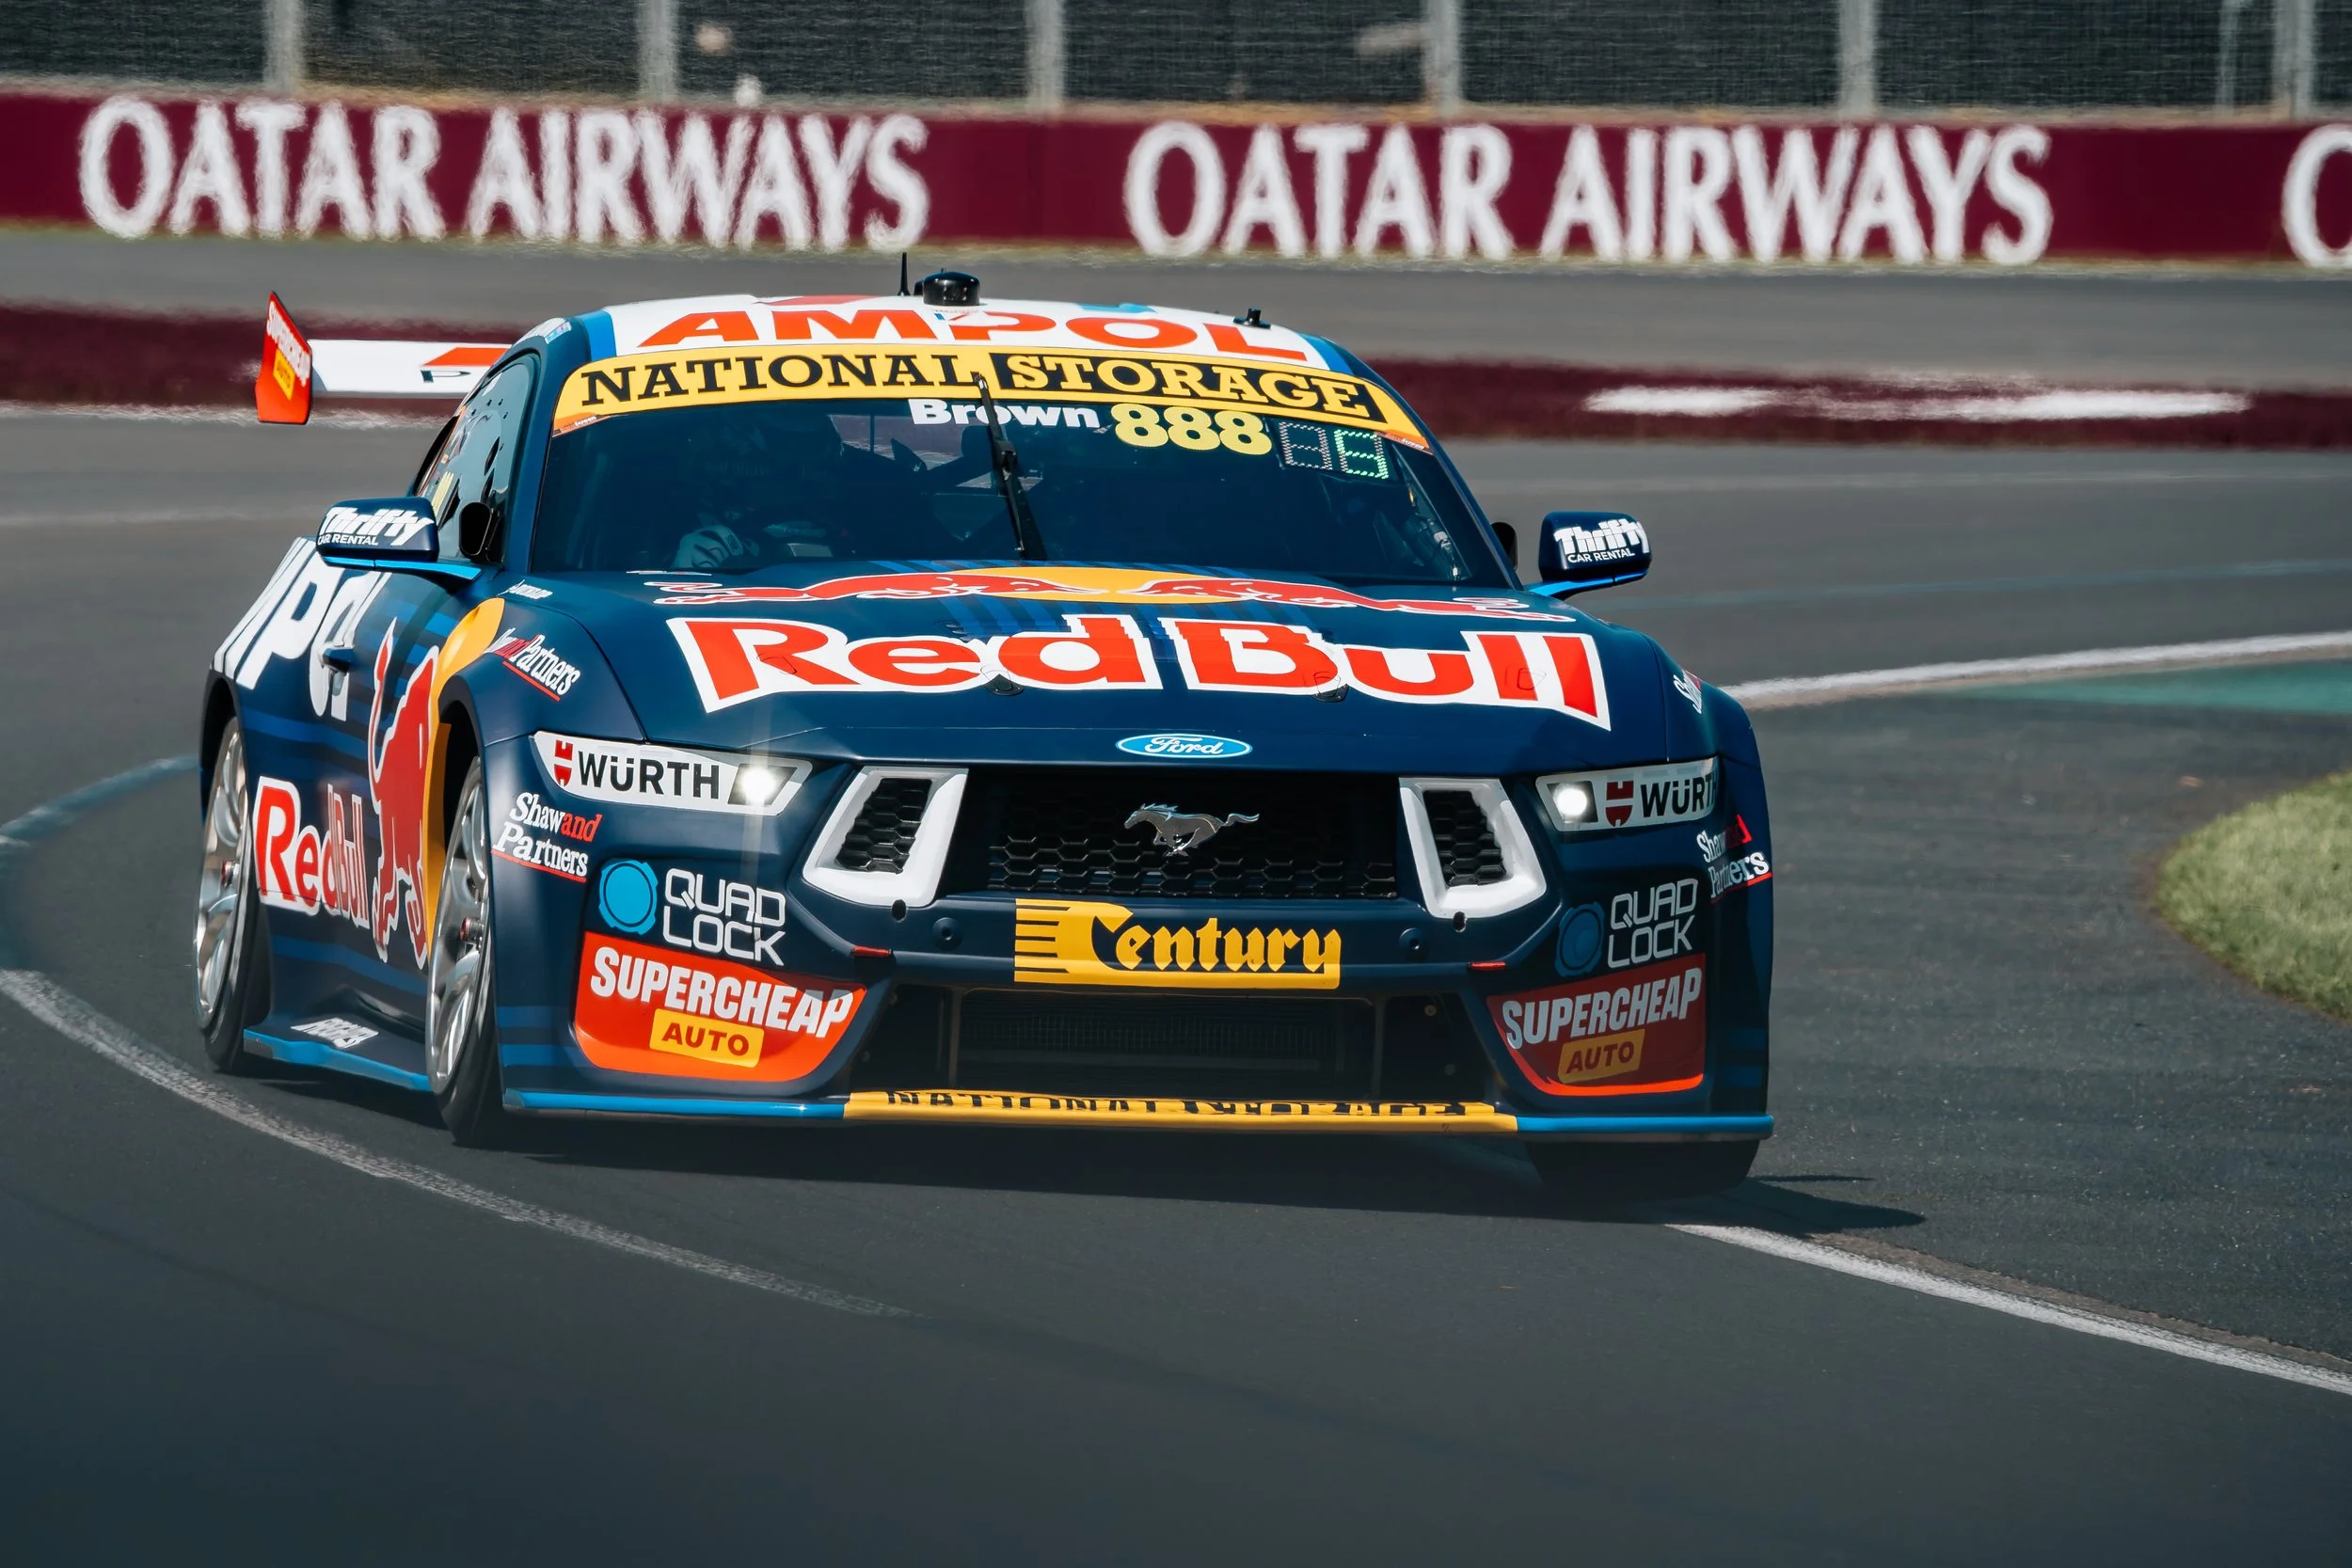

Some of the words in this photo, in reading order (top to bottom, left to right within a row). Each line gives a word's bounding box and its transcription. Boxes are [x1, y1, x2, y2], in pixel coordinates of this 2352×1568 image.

[466, 103, 931, 252] AIRWAYS
[1539, 123, 2054, 266] AIRWAYS
[637, 309, 1308, 361] AMPOL
[580, 354, 984, 406] NATIONAL
[1006, 355, 1371, 418] STORAGE
[907, 398, 1101, 429] Brown
[1110, 403, 1273, 455] 888
[318, 506, 435, 546] Thrifty
[331, 533, 379, 546] RENTAL
[1552, 517, 1650, 562] Thrifty
[1567, 550, 1593, 564] CAR
[1595, 547, 1636, 562] RENTAL
[670, 617, 1159, 712] Red
[1160, 617, 1610, 731] Bull
[1144, 736, 1224, 755] Ford
[253, 776, 341, 917] Red
[492, 821, 589, 879] Partners
[664, 867, 787, 927] QUAD
[1610, 878, 1699, 929] QUAD
[662, 905, 787, 967] LOCK
[1035, 898, 1342, 990] Century
[1607, 914, 1695, 969] LOCK
[590, 946, 855, 1038] SUPERCHEAP
[1502, 967, 1702, 1050] SUPERCHEAP
[661, 1022, 751, 1056] AUTO
[1565, 1040, 1635, 1074] AUTO
